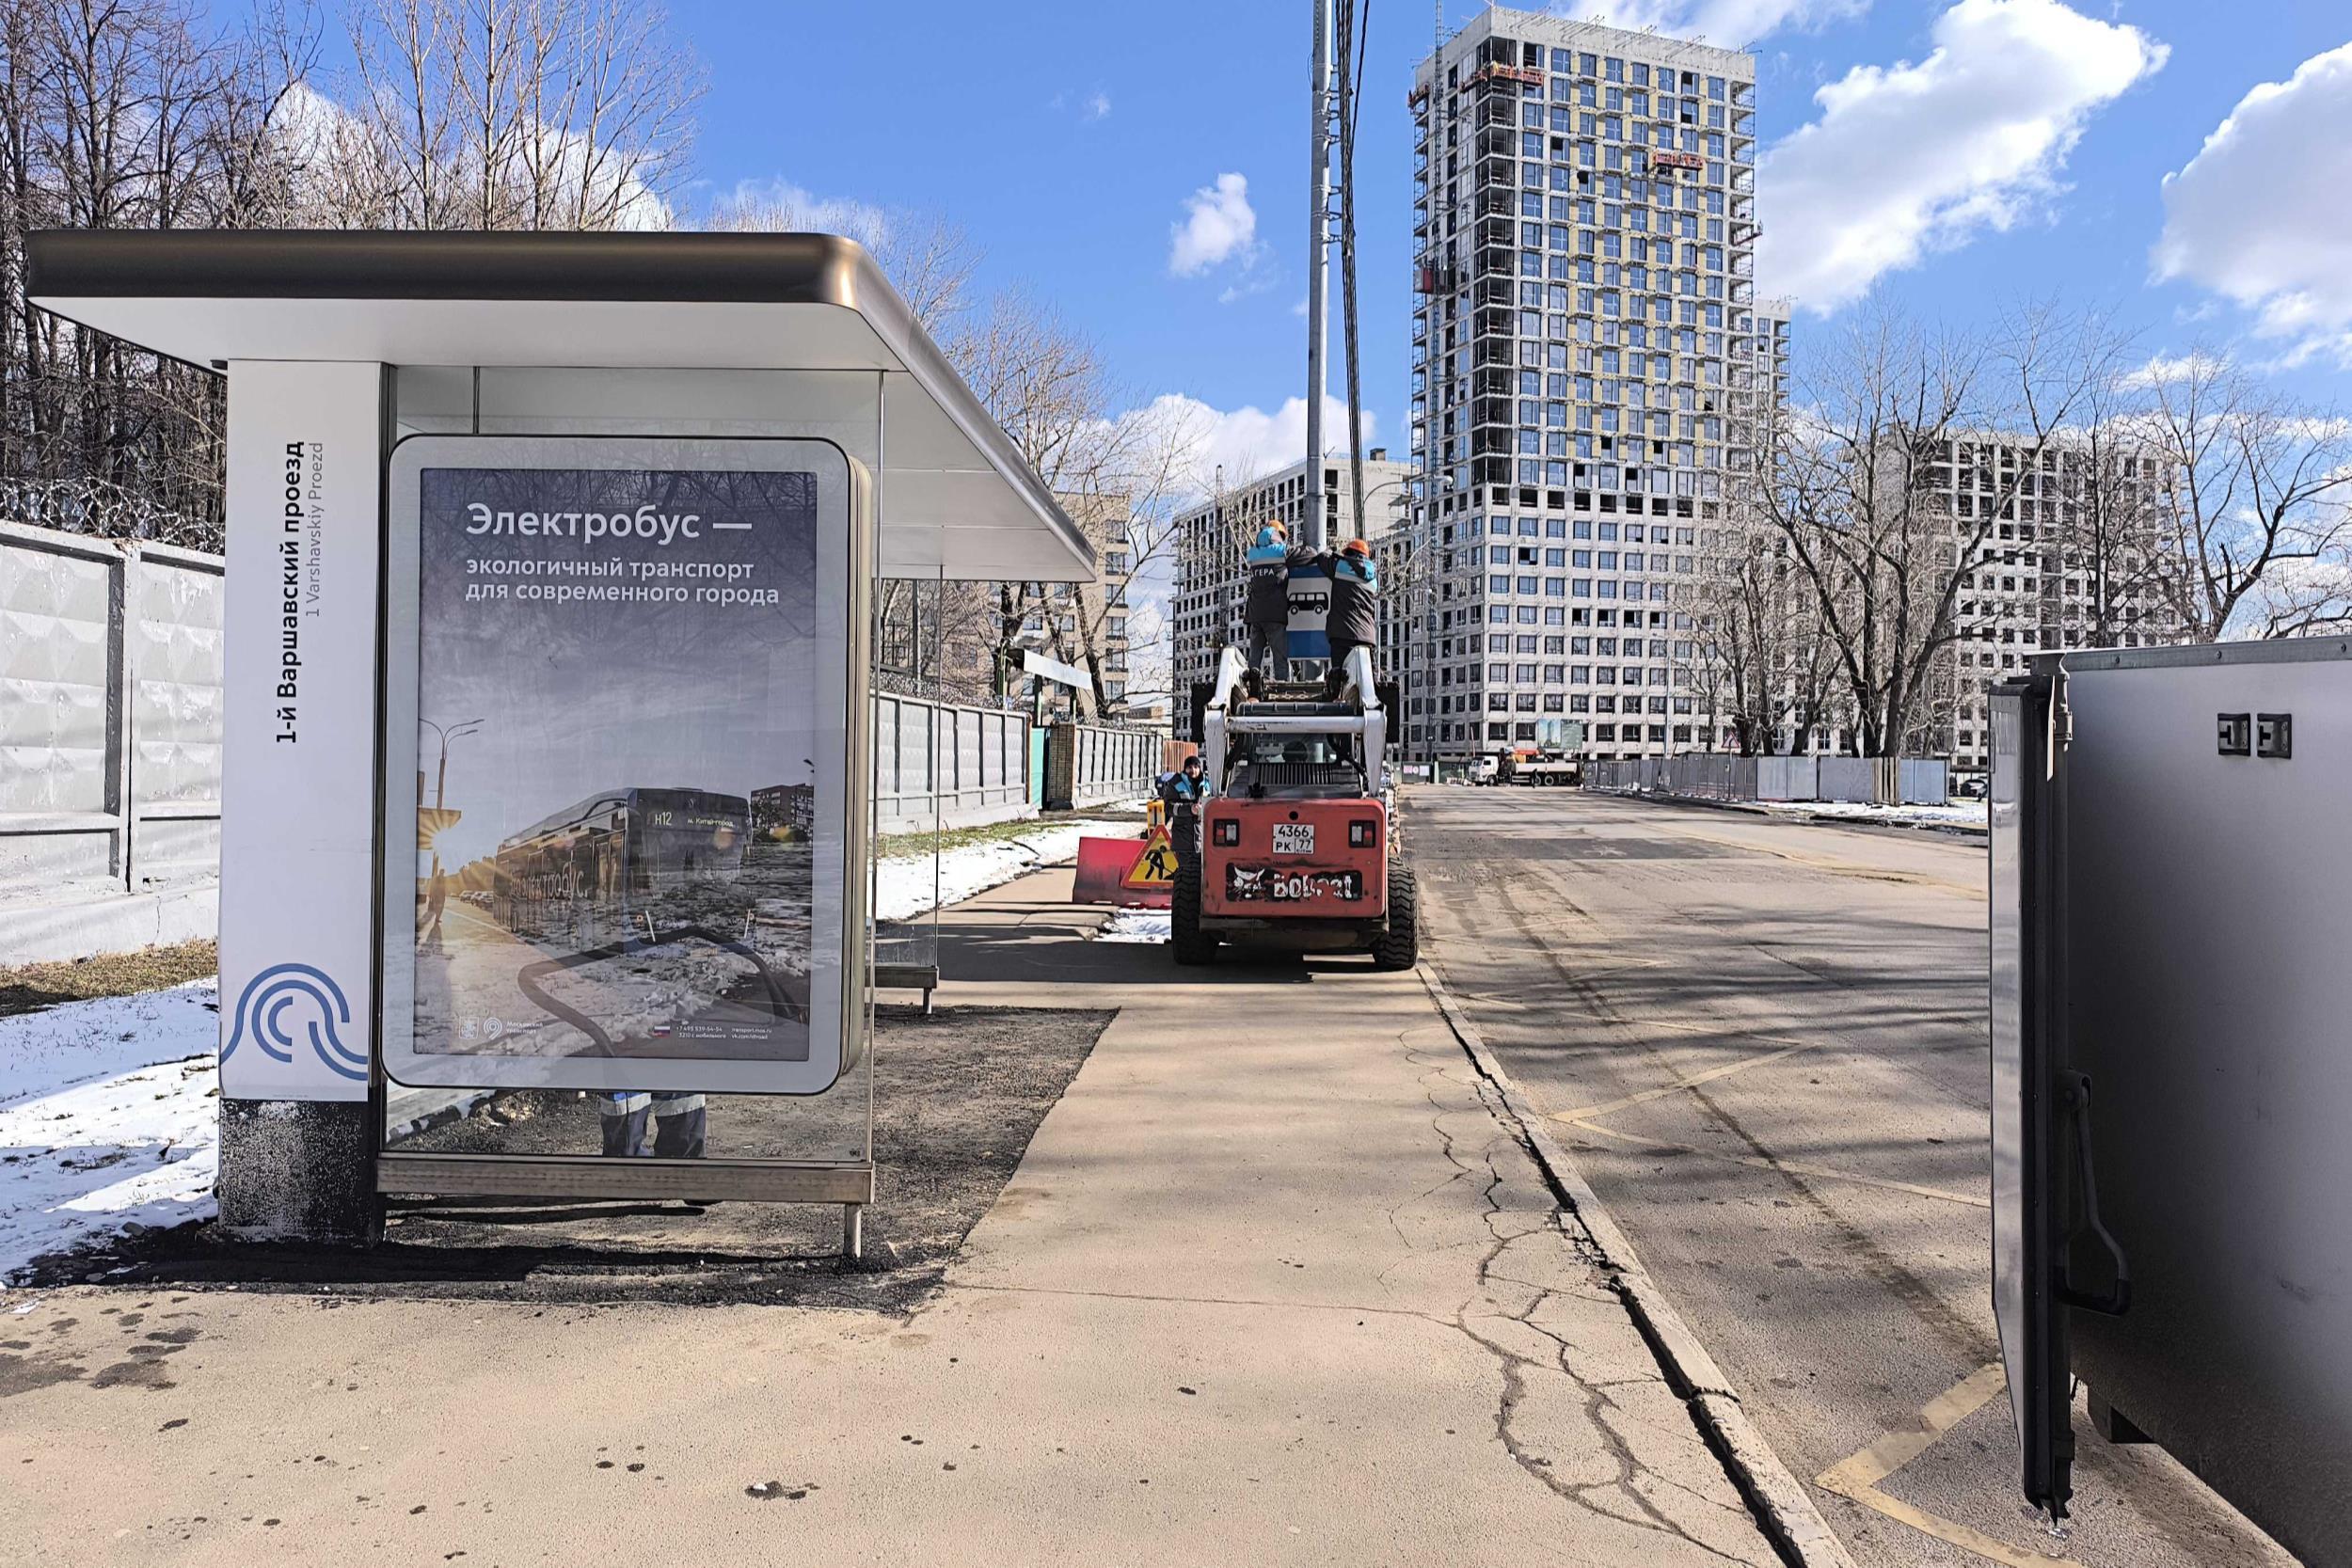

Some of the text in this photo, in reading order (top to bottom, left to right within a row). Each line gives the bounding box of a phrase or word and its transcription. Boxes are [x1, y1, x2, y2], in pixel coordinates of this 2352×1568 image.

[306, 442, 325, 617] 1 Varshavskiy Proezd
[466, 502, 701, 546] Электробус
[466, 556, 755, 582] экологичный транспорт
[276, 441, 305, 743] 1-й Варшавский проезд
[465, 583, 779, 608] для современного города
[1278, 825, 1310, 837] 4366
[1298, 839, 1311, 849] 77
